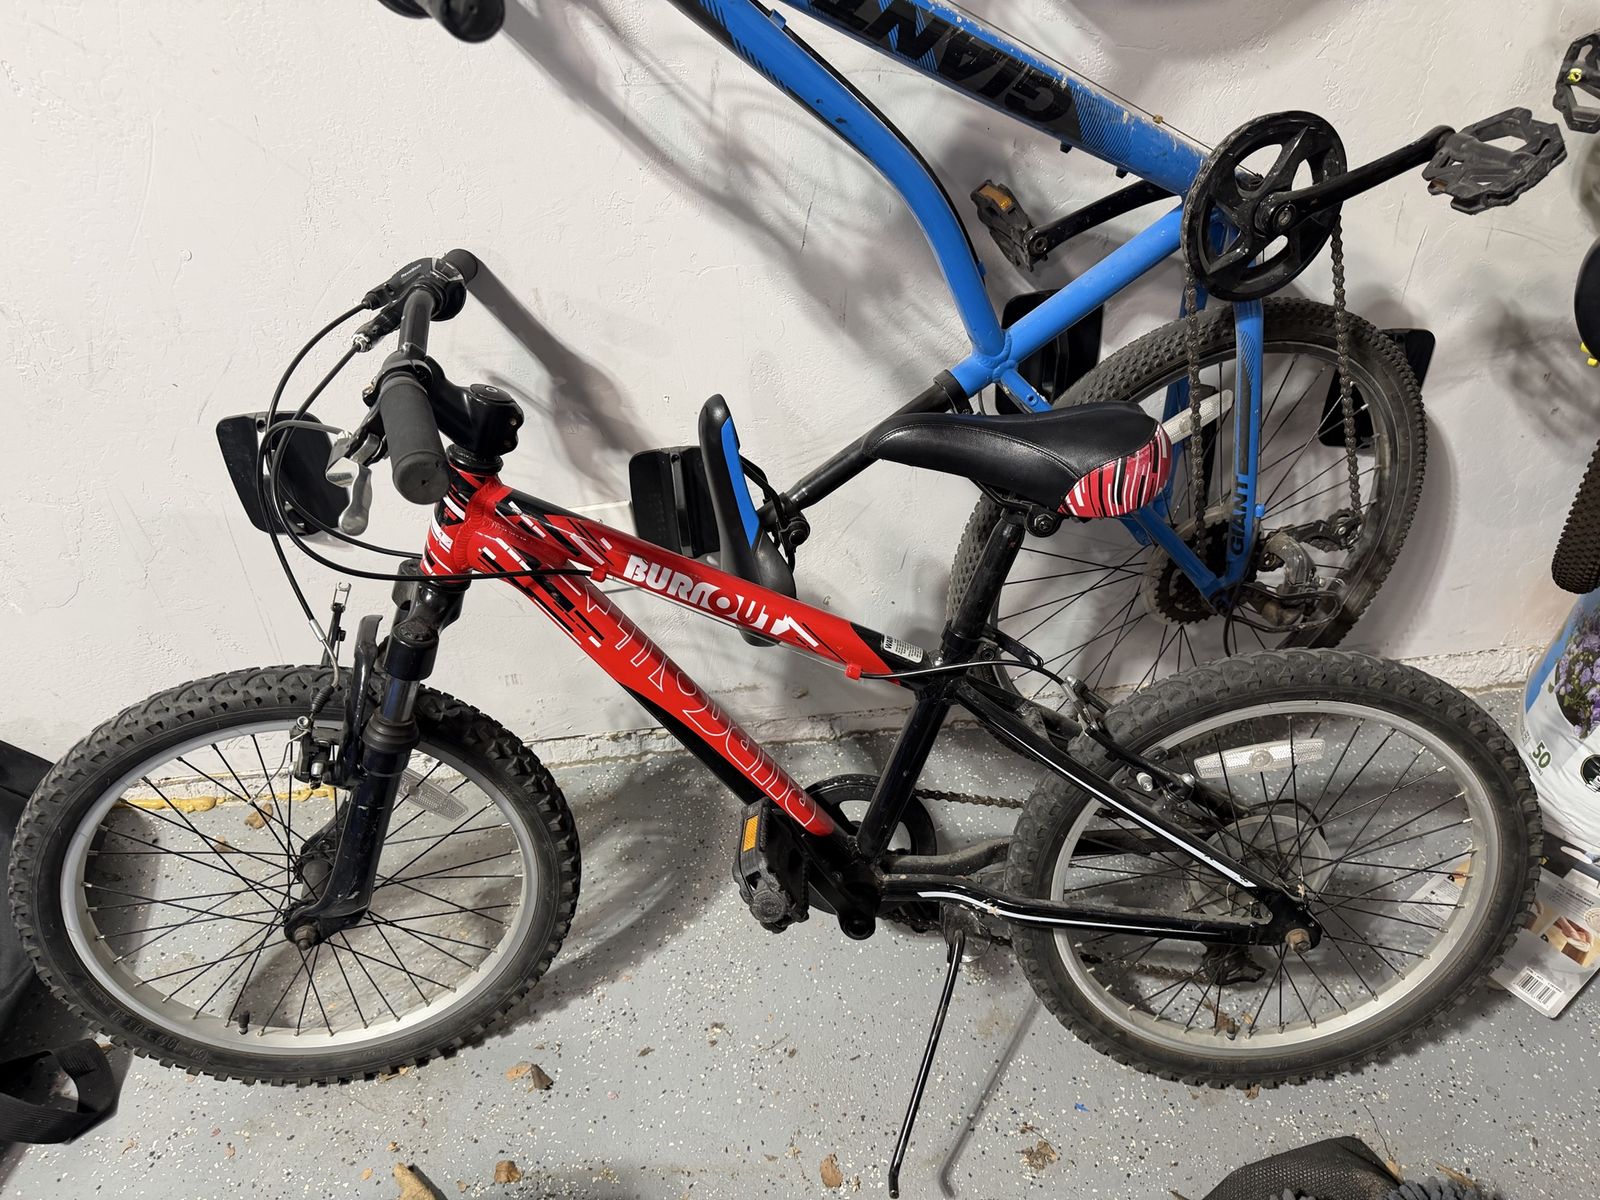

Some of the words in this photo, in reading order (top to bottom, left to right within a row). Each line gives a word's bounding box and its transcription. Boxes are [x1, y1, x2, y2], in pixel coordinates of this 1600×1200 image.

[810, 0, 1073, 123] GIANT
[1231, 476, 1249, 555] GIANT
[623, 554, 797, 636] BURNOUT
[1532, 741, 1551, 769] 50
